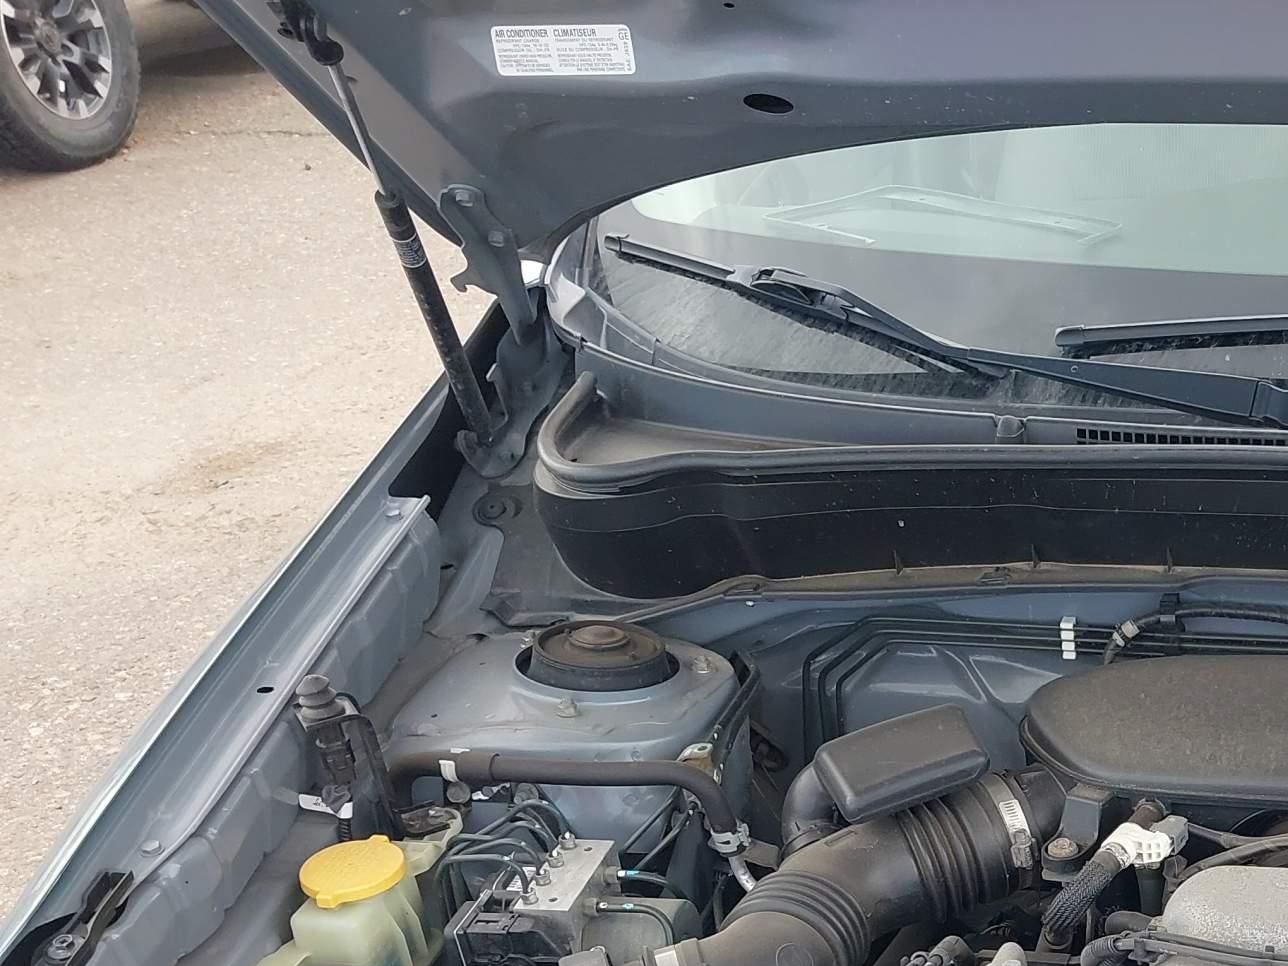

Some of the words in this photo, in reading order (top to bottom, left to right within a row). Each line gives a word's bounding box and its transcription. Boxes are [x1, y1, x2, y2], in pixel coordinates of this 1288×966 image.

[495, 29, 505, 38] AIR
[506, 29, 549, 38] CONDITIONER
[553, 28, 597, 37] CLIMATISEUR
